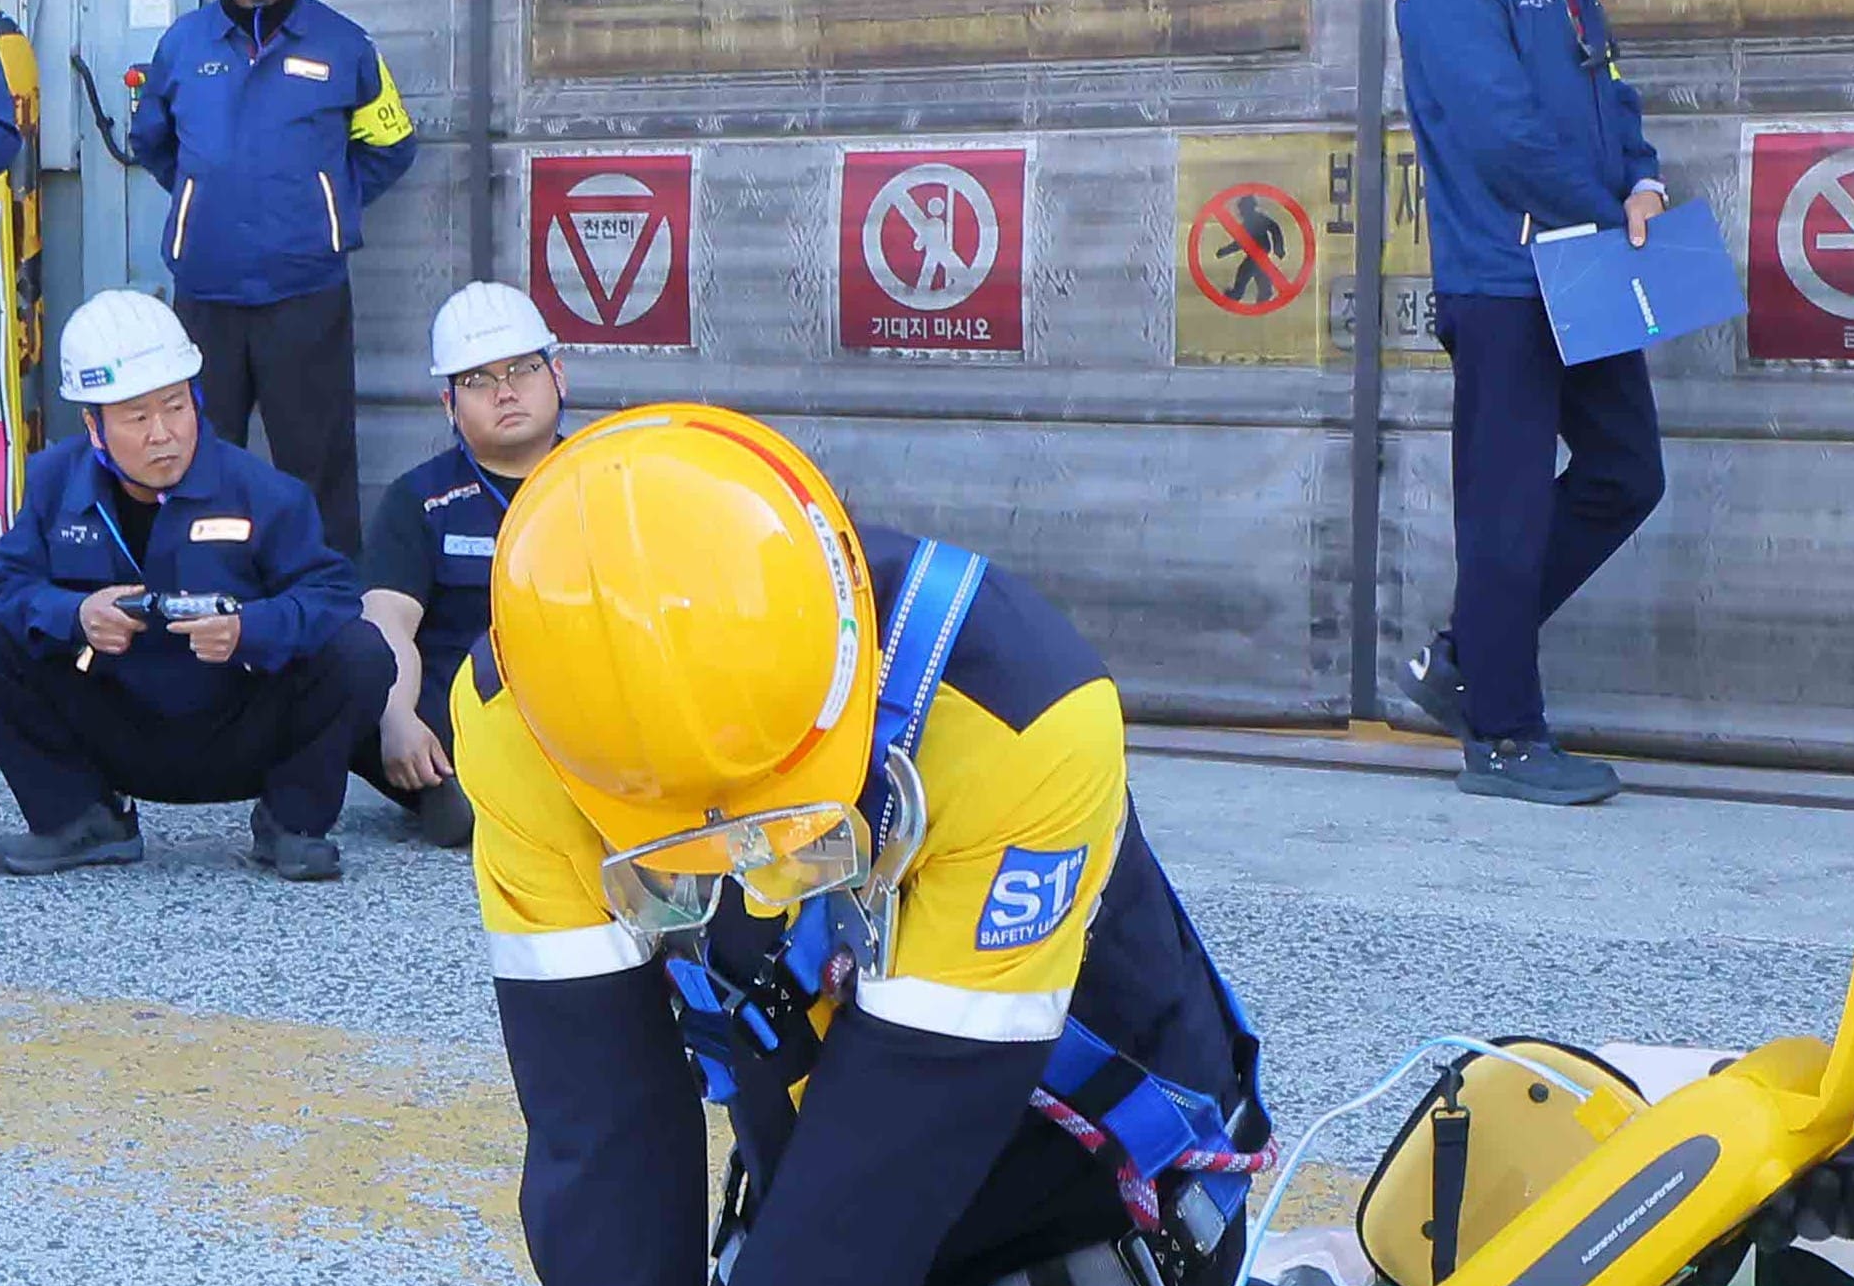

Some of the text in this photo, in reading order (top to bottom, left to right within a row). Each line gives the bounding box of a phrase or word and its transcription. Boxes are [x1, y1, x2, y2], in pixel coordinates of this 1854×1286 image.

[870, 317, 991, 341] 기대지 마시오
[980, 924, 1035, 945] SAFETY
